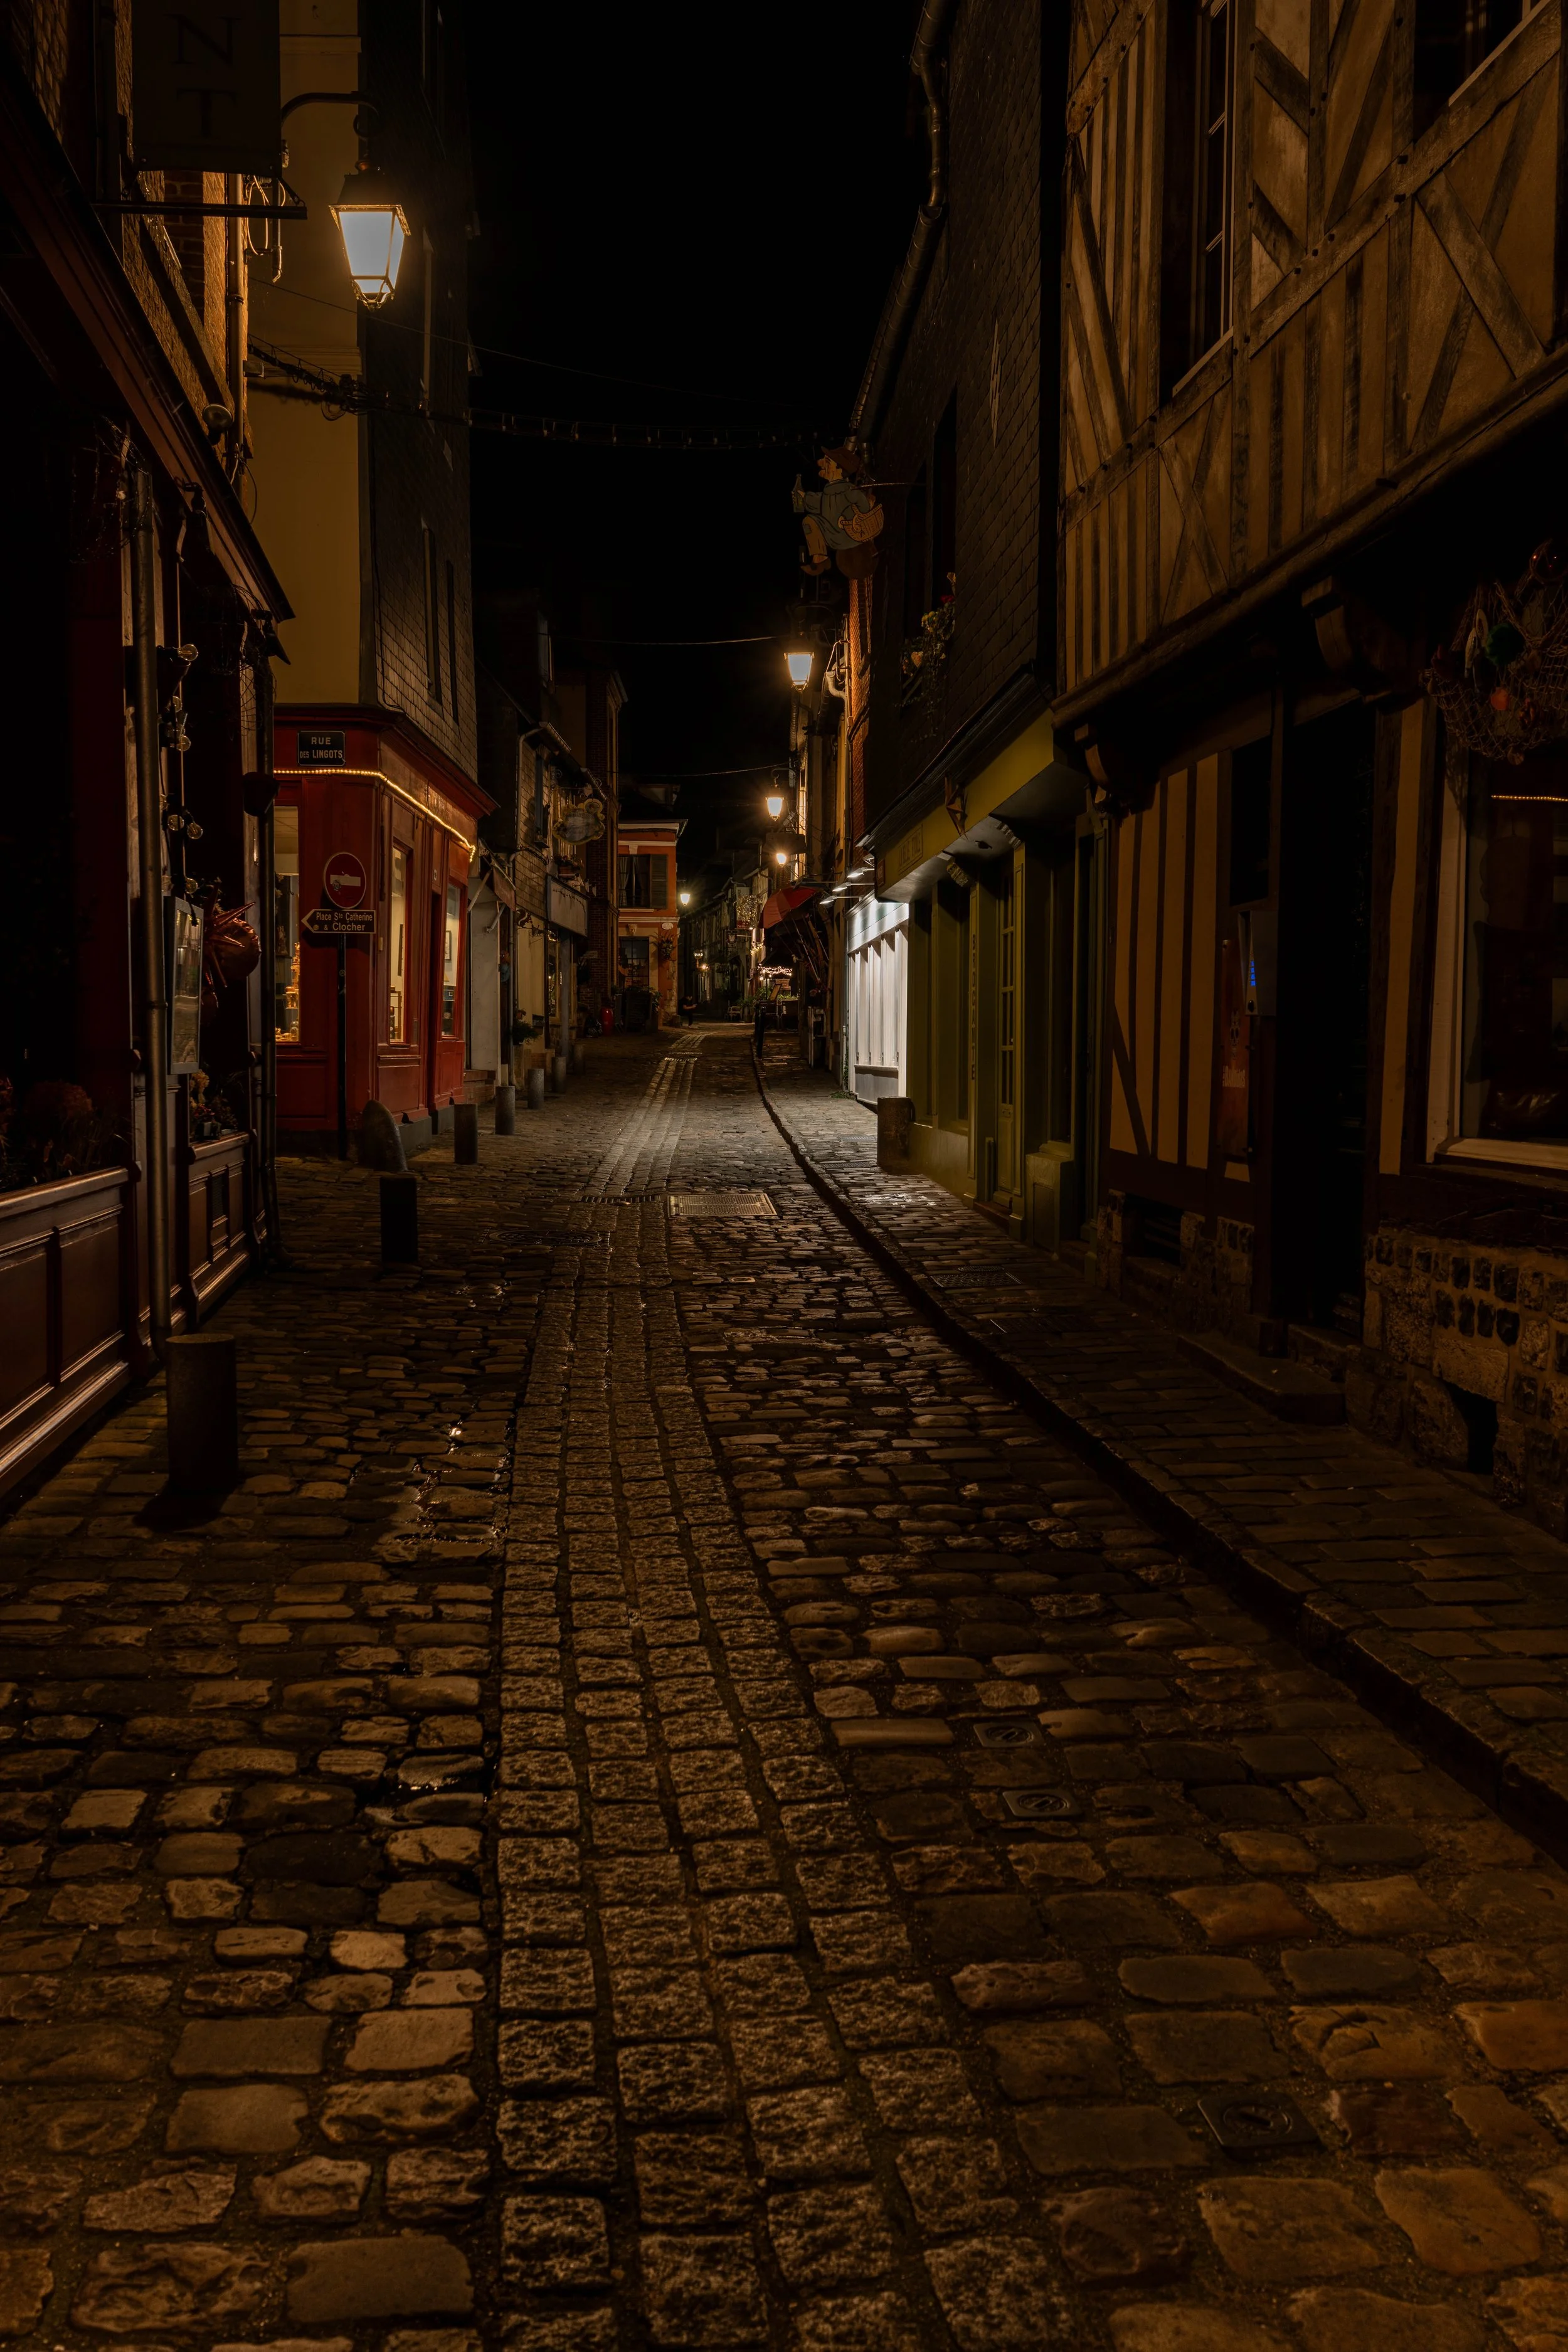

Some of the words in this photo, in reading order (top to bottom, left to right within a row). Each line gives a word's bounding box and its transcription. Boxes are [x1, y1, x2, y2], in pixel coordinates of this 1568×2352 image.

[311, 737, 331, 745] RUE
[300, 750, 310, 758] DES
[312, 750, 343, 759] LINGOTS
[316, 912, 332, 921] Place
[346, 912, 373, 921] Catherine
[332, 922, 366, 931] Clocher
